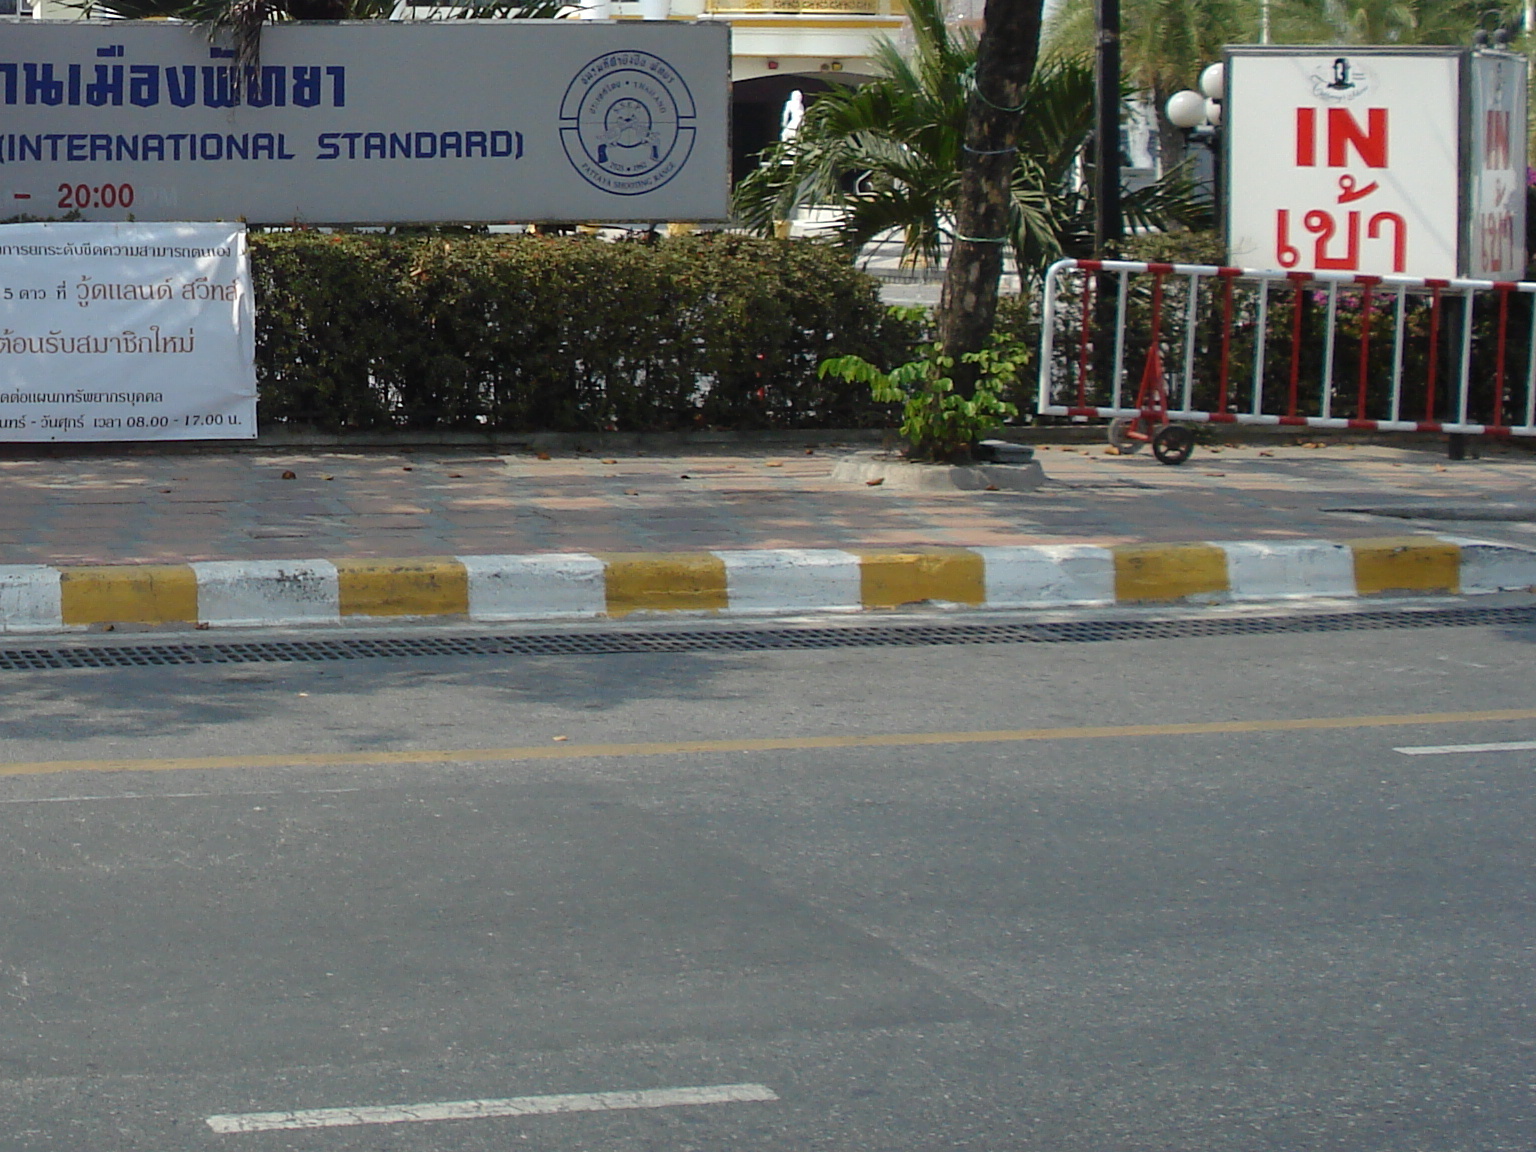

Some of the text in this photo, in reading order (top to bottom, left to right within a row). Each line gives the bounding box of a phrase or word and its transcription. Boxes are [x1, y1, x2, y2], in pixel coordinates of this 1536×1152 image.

[317, 131, 524, 161] STANDARD)
[1295, 107, 1388, 168] IN
[57, 183, 135, 209] 20:00
[1275, 173, 1407, 274] เข้า
[3, 287, 14, 300] 5
[18, 288, 47, 301] ดาว
[56, 280, 68, 301] ที่
[93, 418, 122, 429] เวลา
[126, 415, 169, 429] 08.00
[183, 413, 224, 427] 17.00
[227, 414, 242, 426] น.
